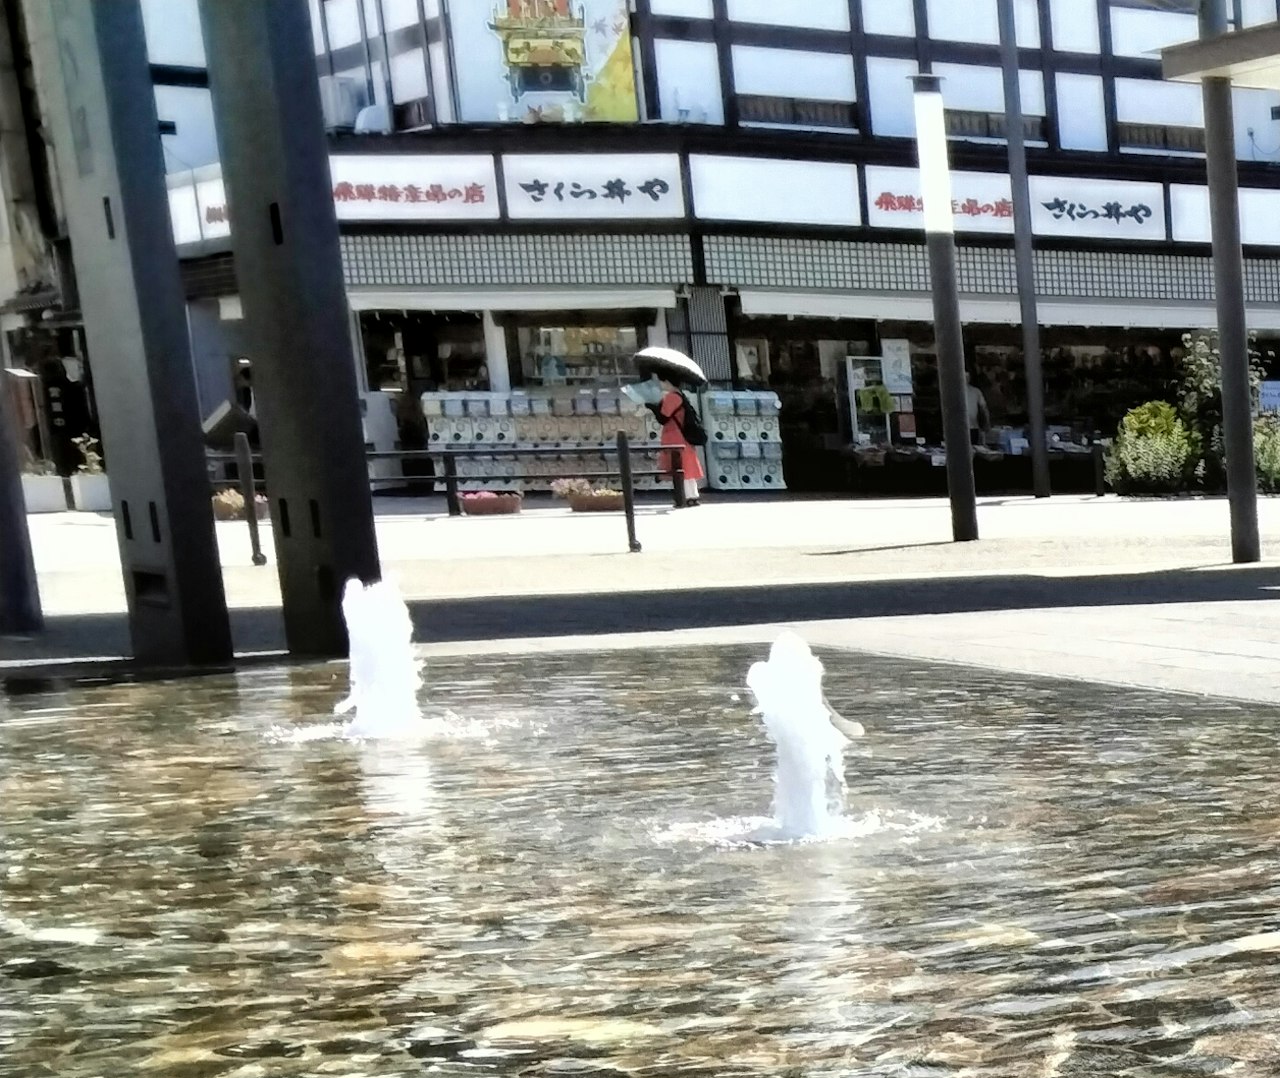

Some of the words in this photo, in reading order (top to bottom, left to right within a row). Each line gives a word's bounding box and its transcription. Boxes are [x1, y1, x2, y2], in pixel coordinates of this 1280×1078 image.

[333, 181, 485, 204] 飛騨特産品の店
[874, 192, 1013, 218] 飛騨品の店
